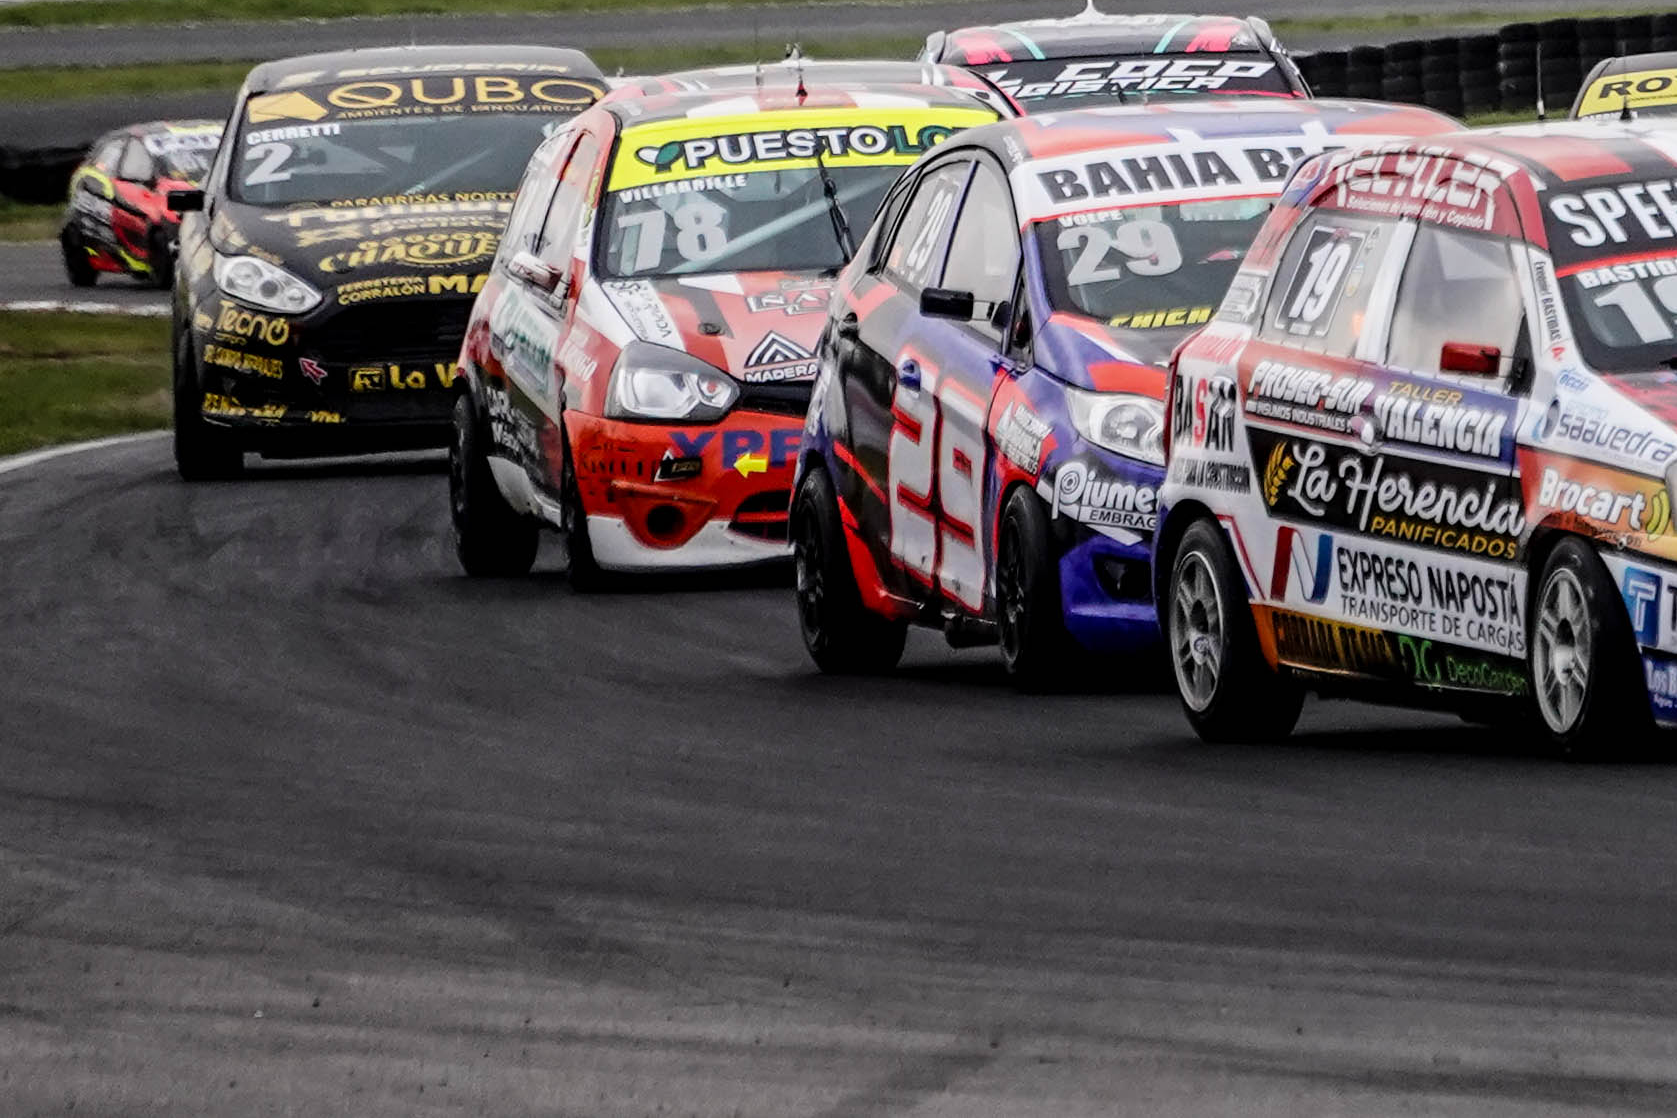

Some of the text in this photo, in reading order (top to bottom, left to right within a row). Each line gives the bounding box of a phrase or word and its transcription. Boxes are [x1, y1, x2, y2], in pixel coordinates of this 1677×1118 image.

[327, 76, 606, 109] QUBO
[1056, 60, 1277, 83] COCO
[245, 123, 341, 147] CERRETTI
[335, 103, 585, 120] AMBIENTES DE VANGUARDIA
[245, 142, 295, 186] 2
[1037, 150, 1242, 205] BAHIA
[330, 192, 449, 208] PARABRISAS
[617, 202, 728, 272] 78
[1056, 218, 1183, 287] 29
[338, 283, 427, 306] CORRALÓN
[1288, 238, 1352, 323] 19
[1541, 295, 1562, 342] BASTIDAS
[1387, 382, 1464, 406] TALLER
[1373, 394, 1508, 458] VALENCIA
[1556, 413, 1677, 463] saavedra
[888, 342, 988, 614] 29
[1287, 443, 1526, 537] La Herencia
[1539, 469, 1647, 528] Brocart
[1370, 515, 1518, 561] PANIFICADOS
[1336, 546, 1522, 628] EXPRESO NAPOSTÁ
[1341, 593, 1526, 653] TRANSPORTE DE CARGAS
